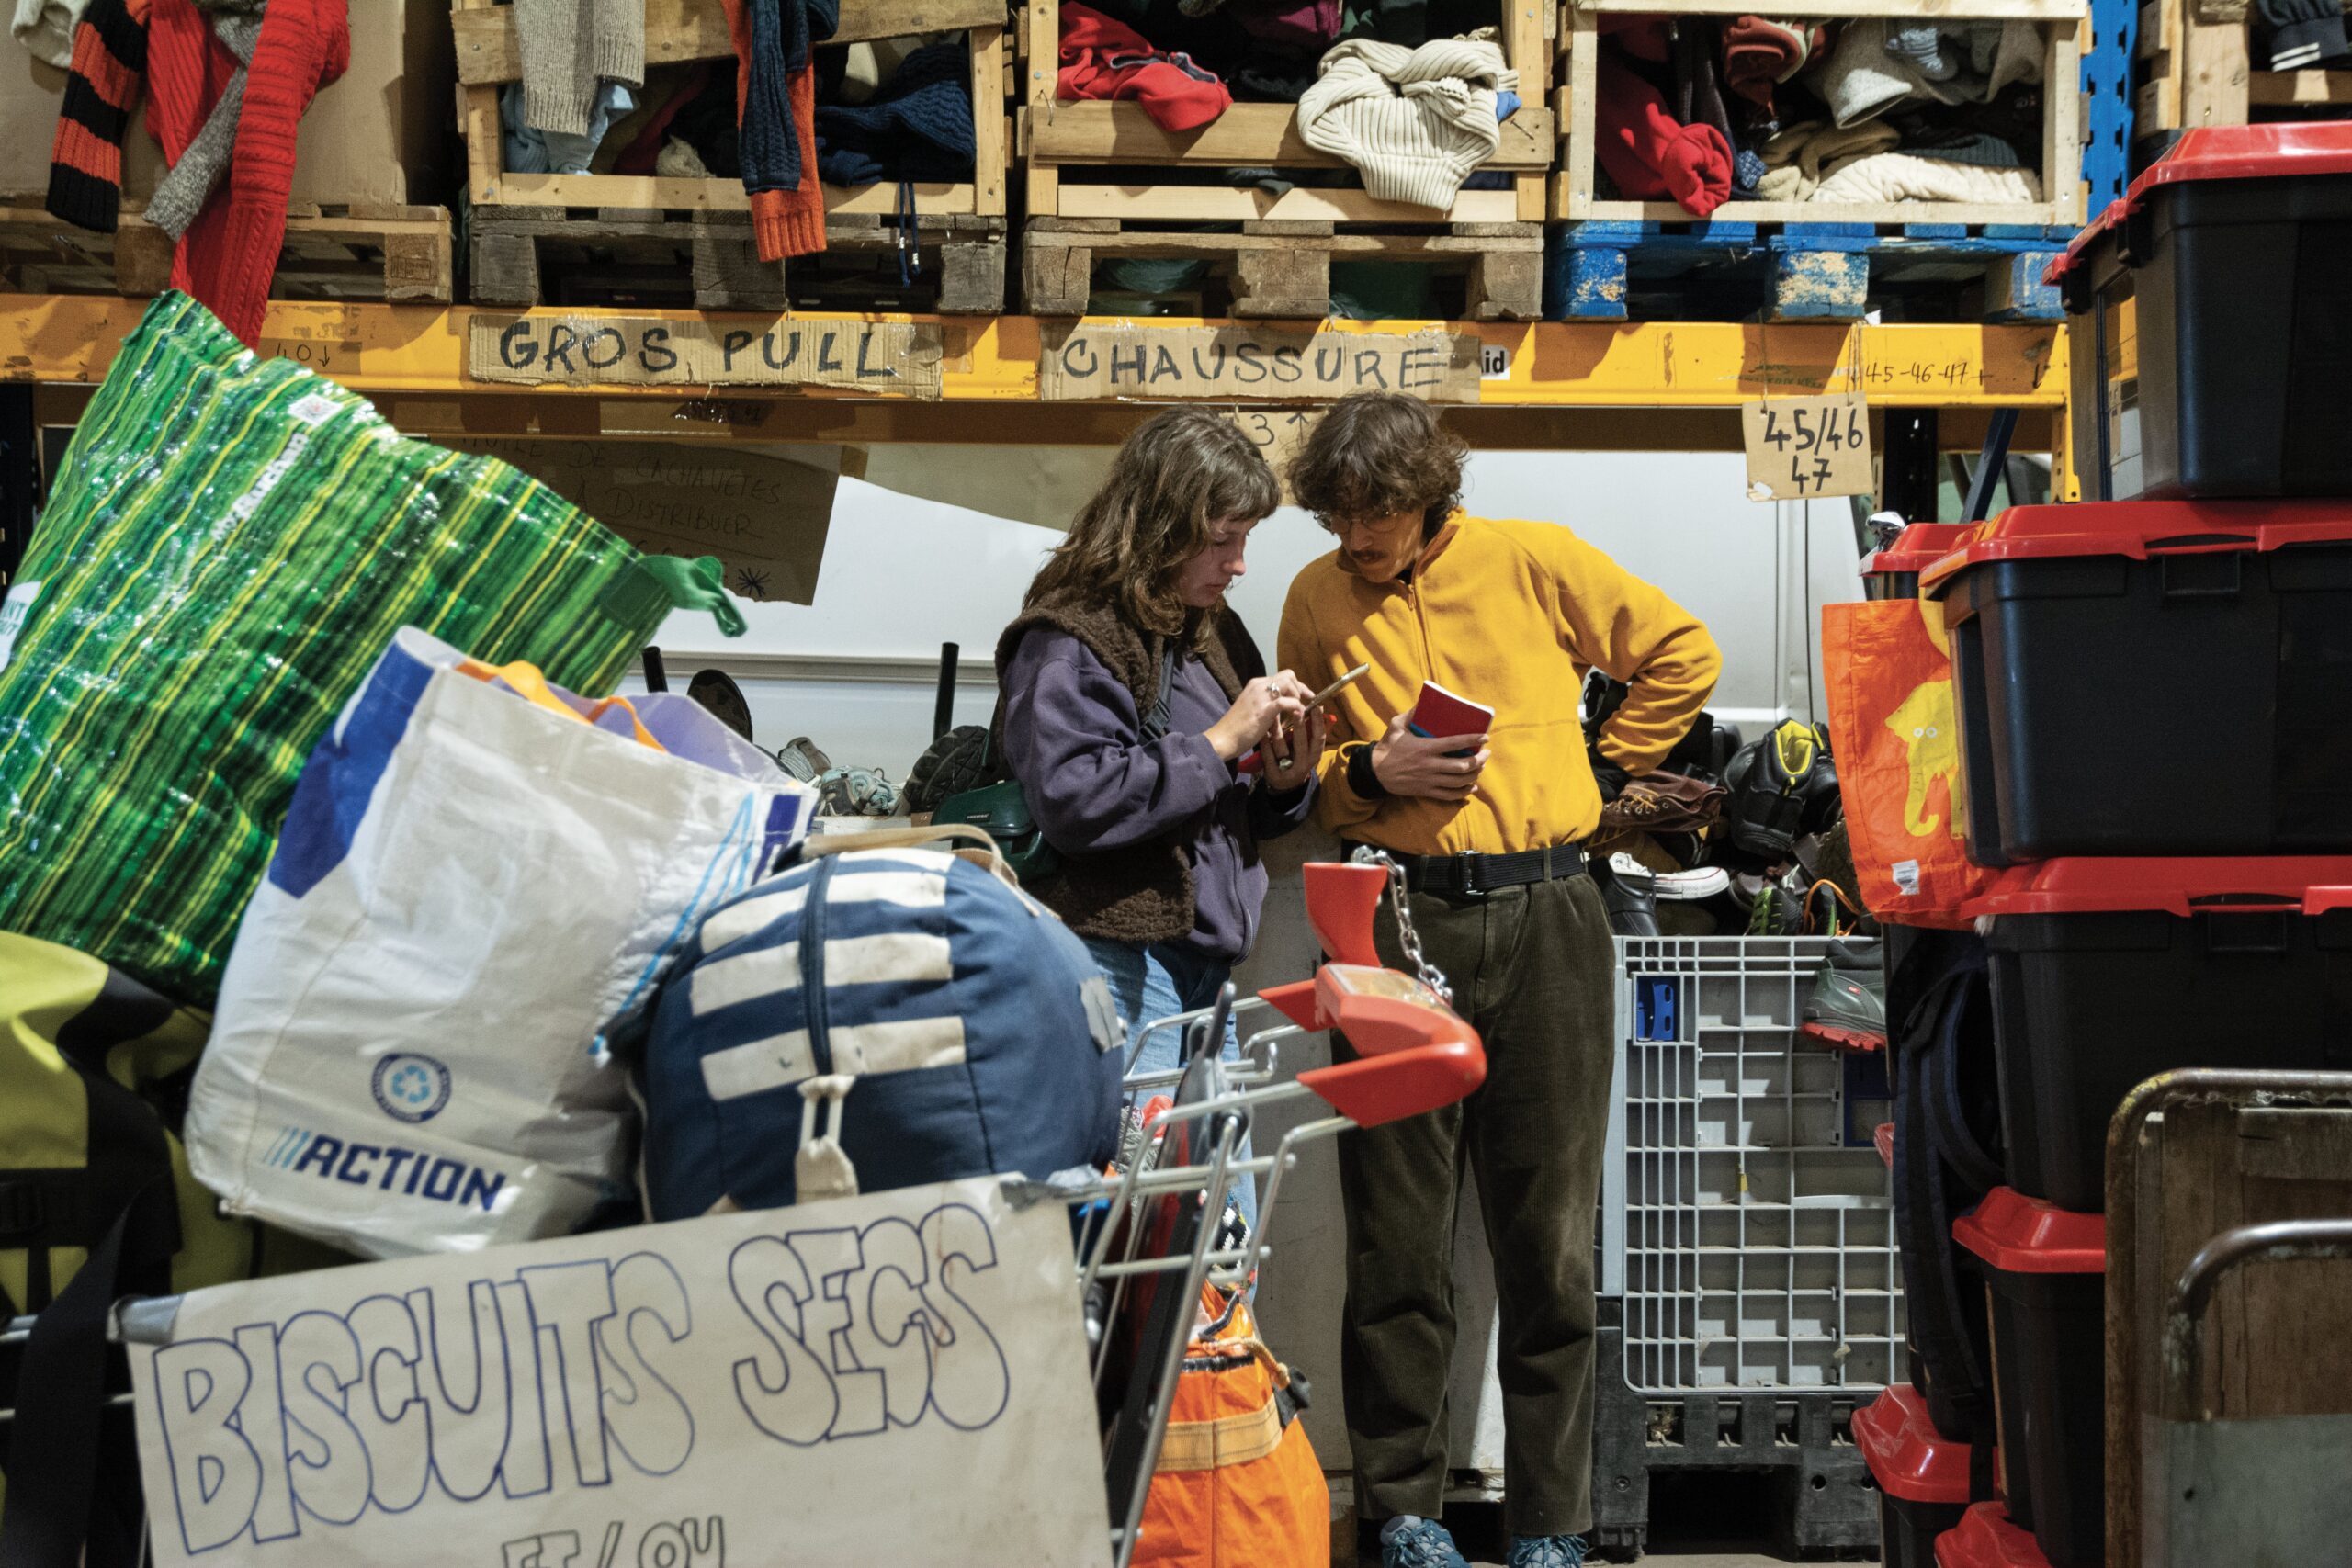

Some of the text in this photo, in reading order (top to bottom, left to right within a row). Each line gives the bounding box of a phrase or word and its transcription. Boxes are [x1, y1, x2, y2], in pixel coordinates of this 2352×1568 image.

[501, 321, 897, 378] GROS PULL
[1063, 338, 1448, 389] CHAUSSURE
[1480, 350, 1505, 374] id
[1764, 408, 1863, 456] 45/46
[1792, 456, 1832, 494] 47
[294, 1134, 507, 1211] ACTION
[152, 1250, 695, 1554] BISCUITS
